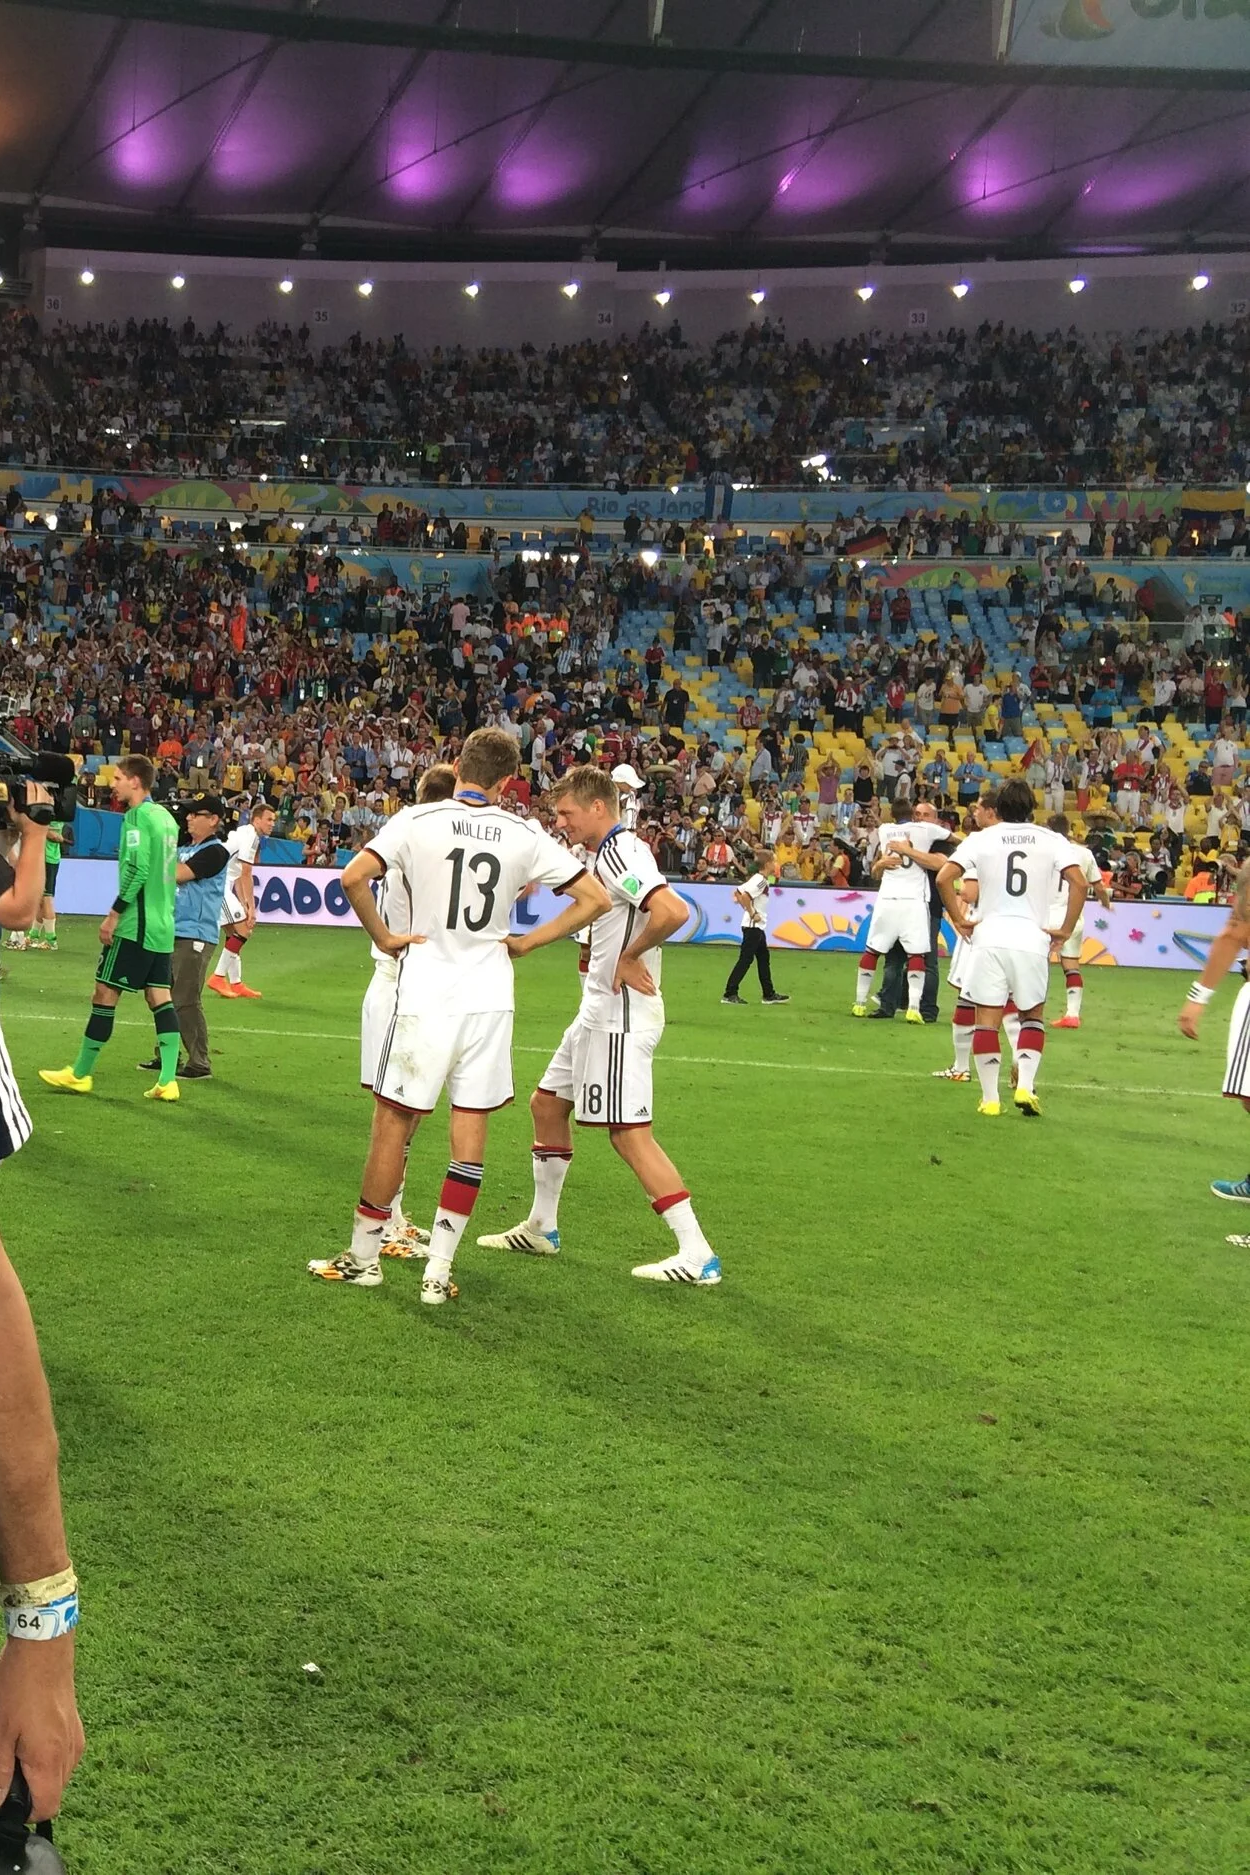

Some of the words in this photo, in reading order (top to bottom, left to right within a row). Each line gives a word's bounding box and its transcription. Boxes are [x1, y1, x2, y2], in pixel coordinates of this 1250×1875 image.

[315, 311, 328, 321] 35
[598, 313, 611, 324] 34
[452, 819, 502, 842] MÜLLER
[1001, 835, 1036, 845] KHEDIRA
[1006, 851, 1028, 897] 6
[445, 847, 501, 932] 13
[582, 1083, 603, 1115] 18
[17, 1613, 41, 1630] 64
